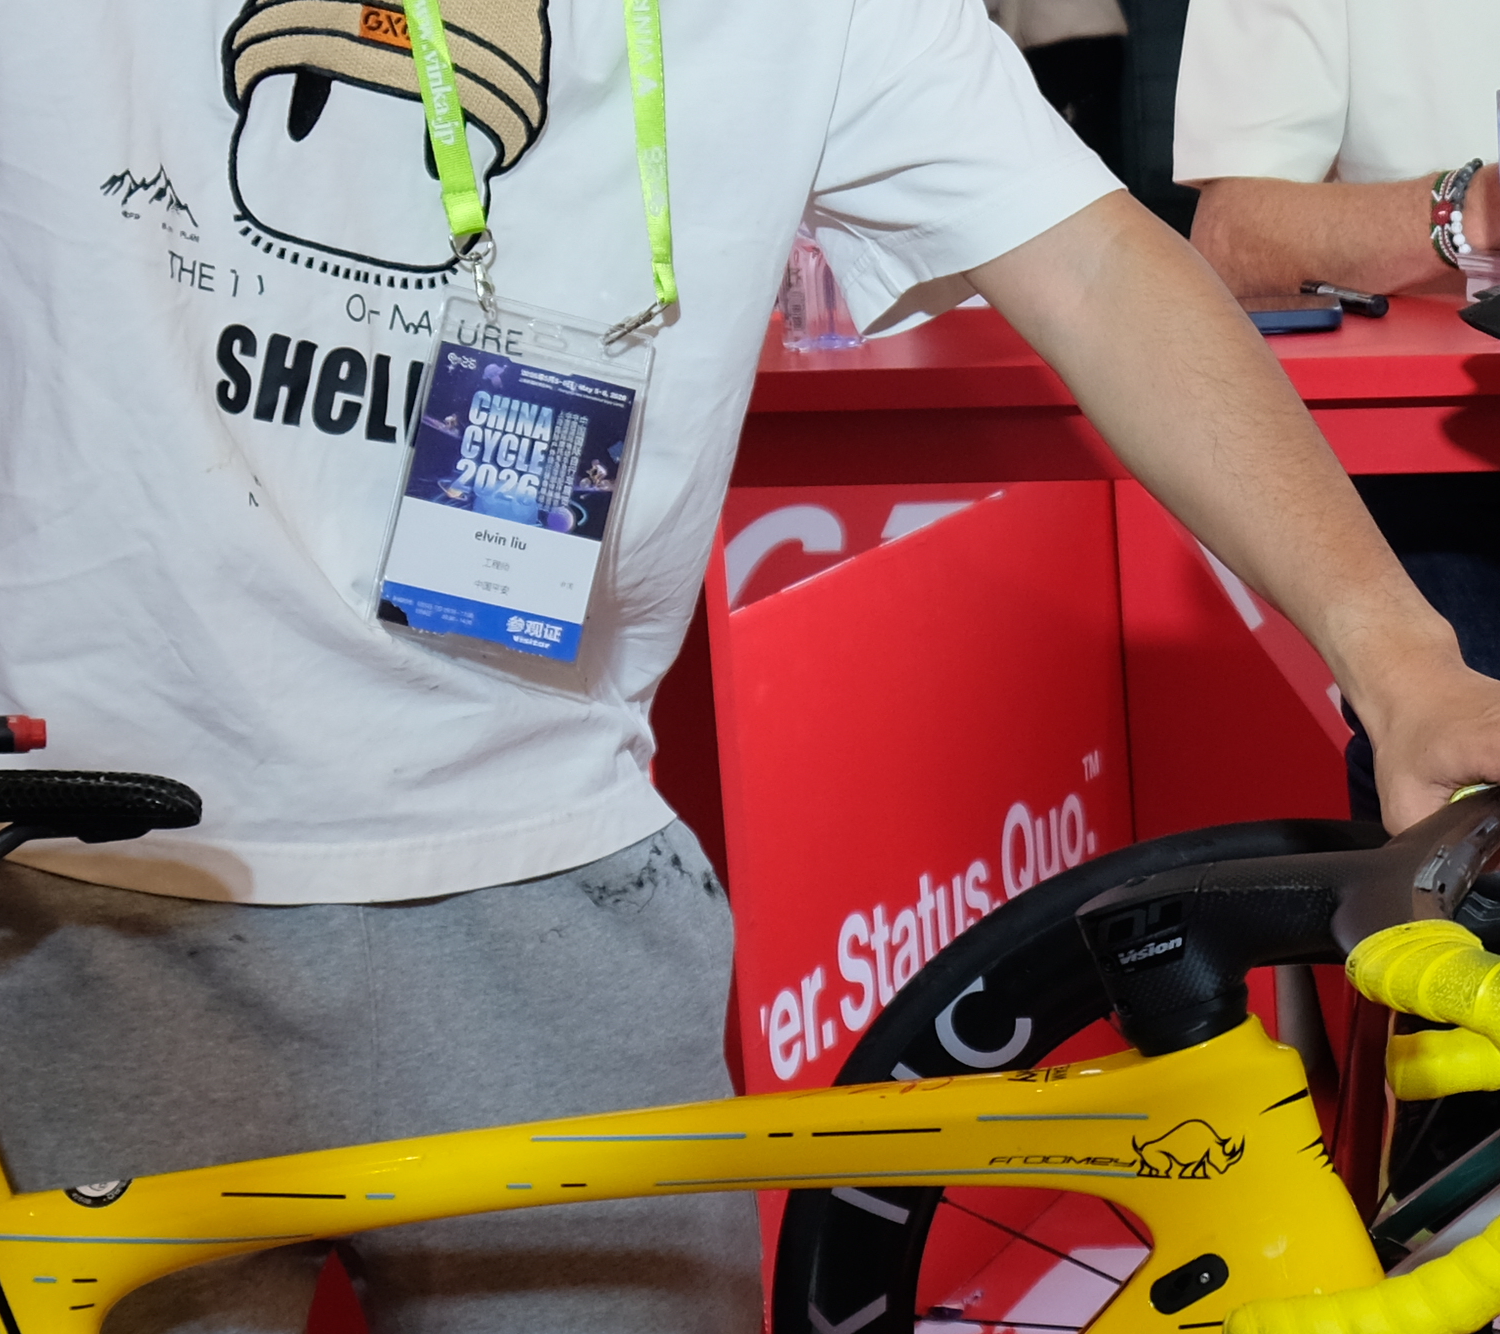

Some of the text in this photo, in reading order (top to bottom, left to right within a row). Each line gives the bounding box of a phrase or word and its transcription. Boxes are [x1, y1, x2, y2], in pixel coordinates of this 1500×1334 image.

[168, 250, 216, 293] THE
[468, 390, 555, 441] CHINA
[460, 424, 550, 476] CYCLE
[456, 458, 541, 503] 2026
[474, 529, 528, 551] elvin liu
[506, 614, 564, 644] 参观证
